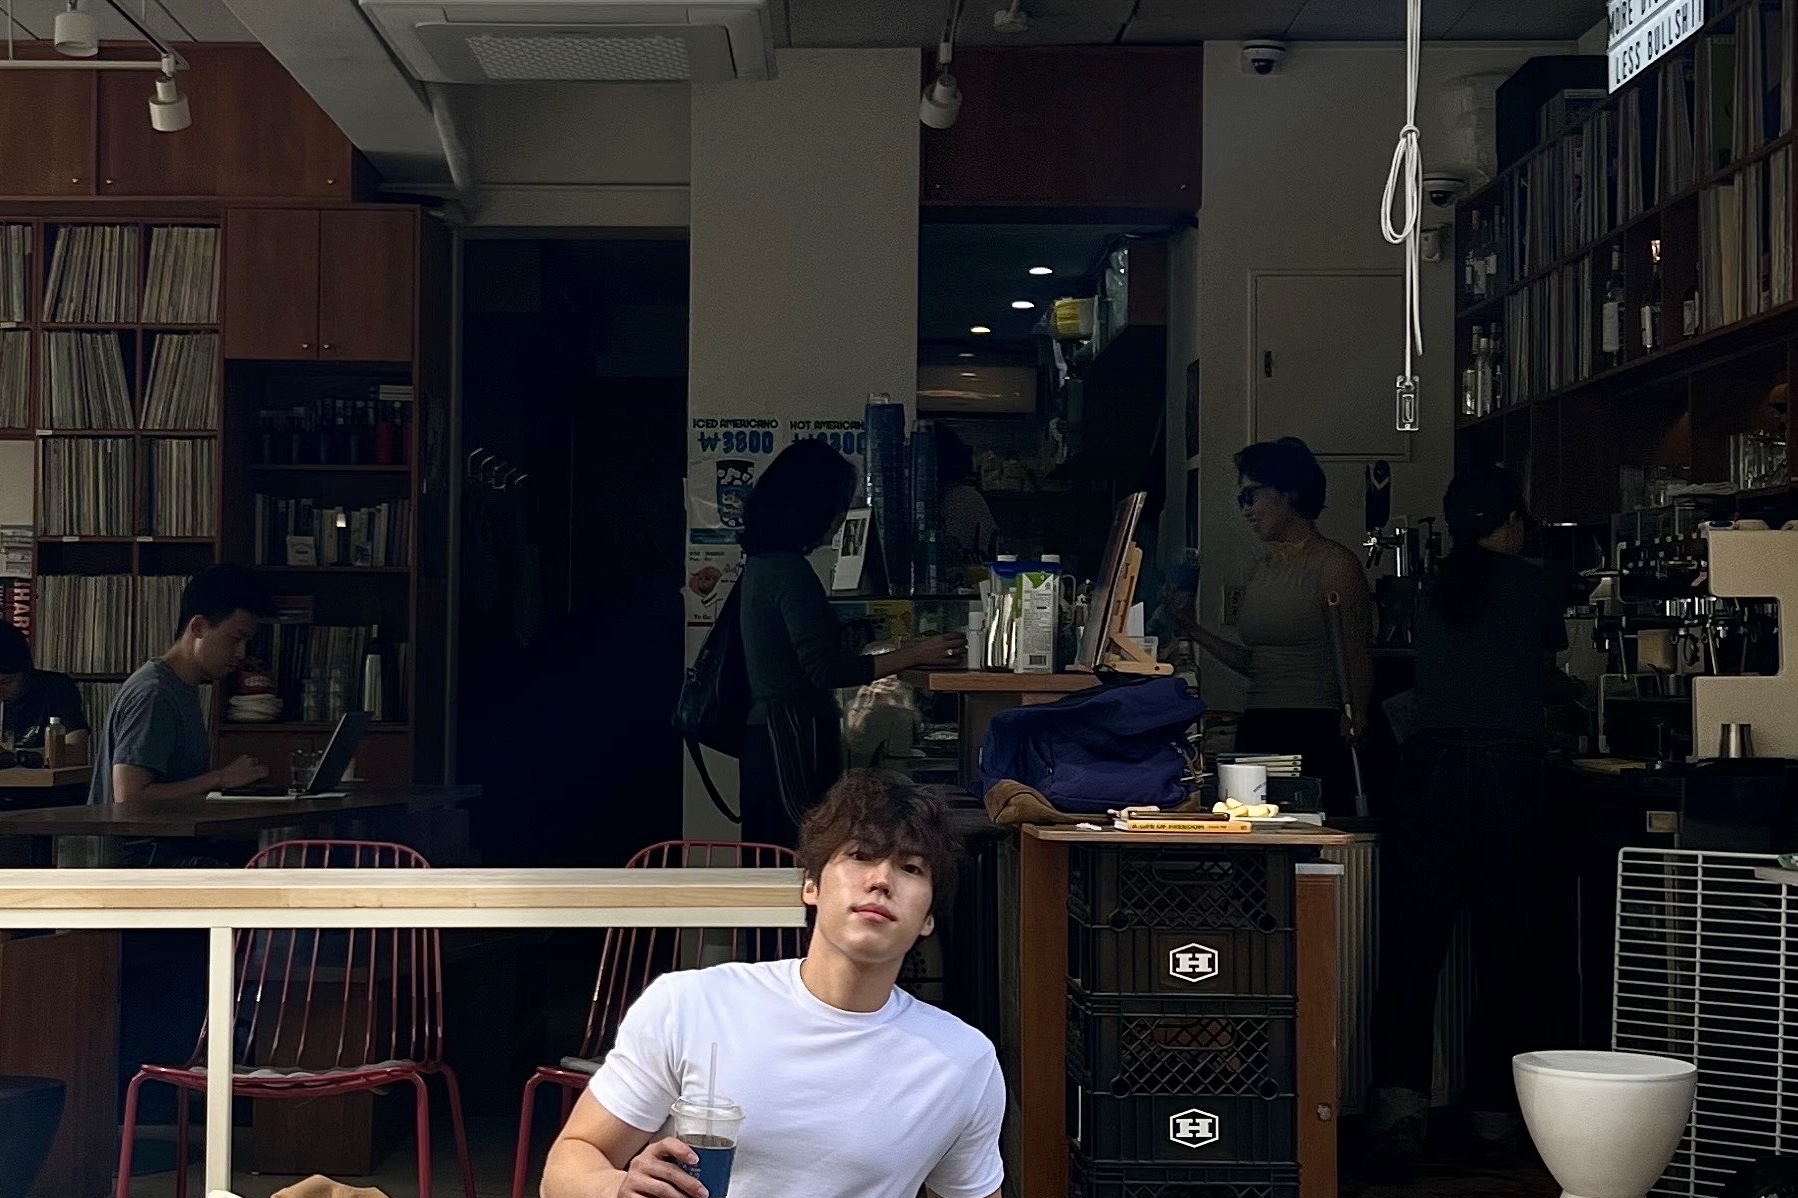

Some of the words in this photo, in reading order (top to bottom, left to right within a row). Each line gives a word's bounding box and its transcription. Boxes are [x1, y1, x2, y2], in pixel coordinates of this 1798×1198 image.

[1616, 41, 1640, 84] LESS
[693, 419, 718, 428] ICED
[720, 419, 778, 428] AMERICANO
[790, 420, 811, 429] HOT
[814, 421, 865, 430] AMERICAN
